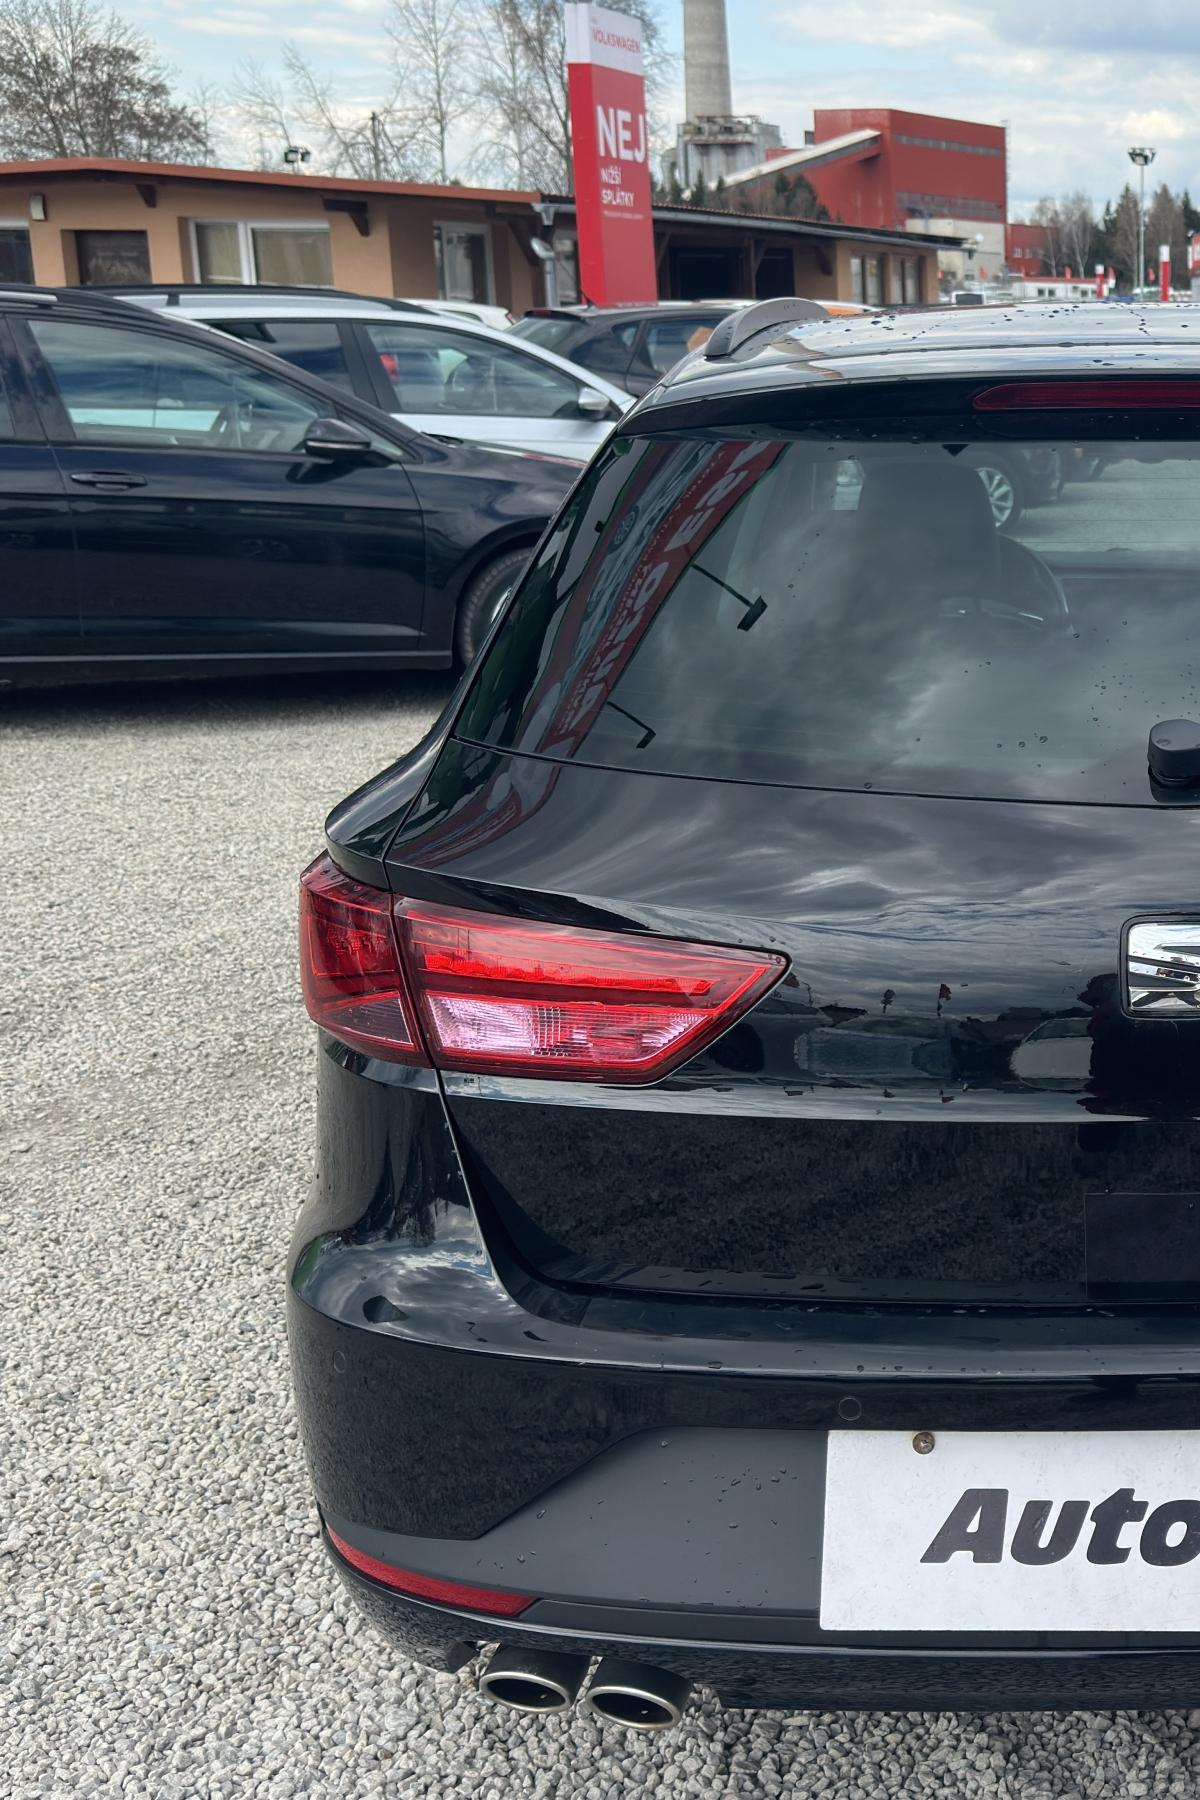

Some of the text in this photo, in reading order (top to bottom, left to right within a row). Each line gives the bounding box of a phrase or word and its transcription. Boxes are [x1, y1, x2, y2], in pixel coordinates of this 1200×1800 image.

[592, 27, 640, 53] VOLKSWAGEN
[597, 104, 646, 163] NEJ
[601, 165, 621, 185] NIŽŠÍ
[602, 187, 634, 207] SPLÁTKY
